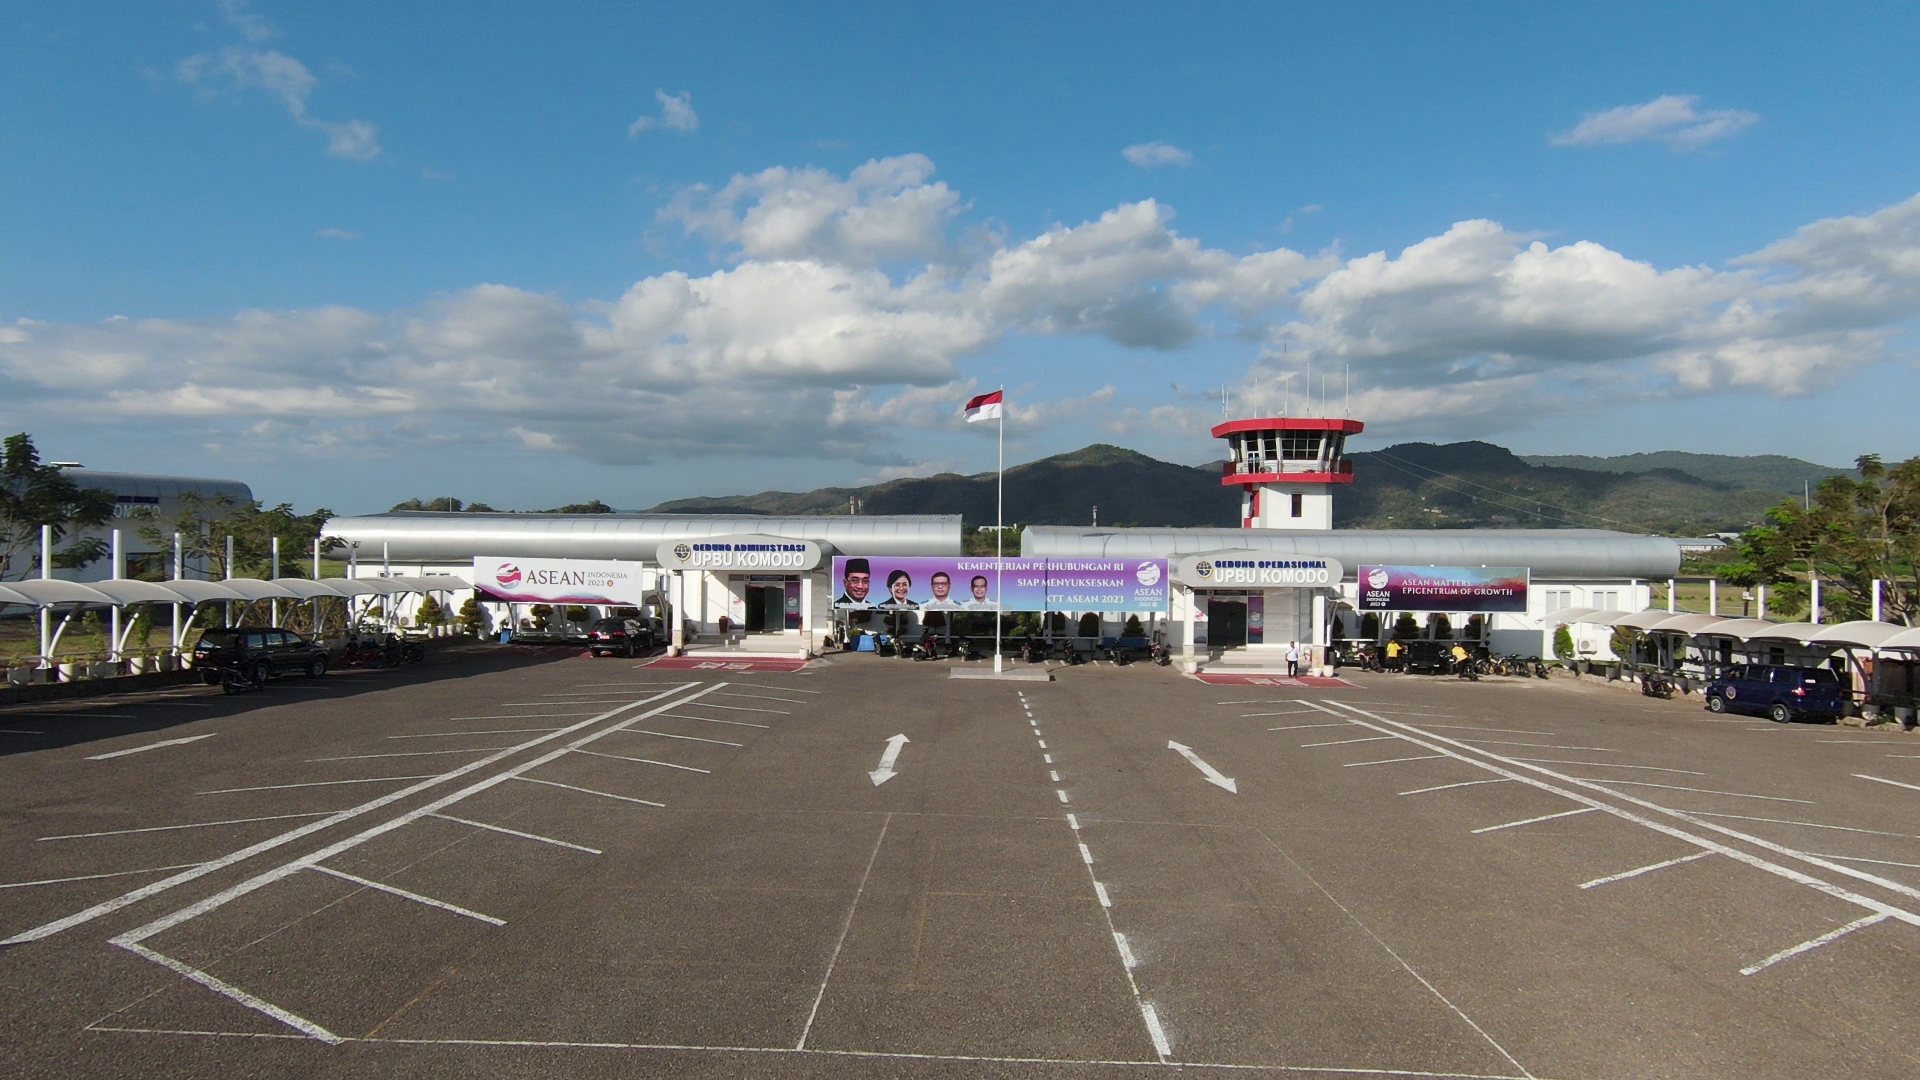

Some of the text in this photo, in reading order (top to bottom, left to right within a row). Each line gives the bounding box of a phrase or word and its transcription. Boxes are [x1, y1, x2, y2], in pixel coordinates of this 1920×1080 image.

[692, 553, 805, 567] UPBU KOMODO
[957, 562, 1124, 571] KEMENTERIAN PERHUBUNGAN RI
[526, 570, 586, 585] ASEAN
[1214, 569, 1329, 584] UPBU KOMODO
[587, 579, 605, 587] 2023
[1017, 578, 1124, 587] SIAP MENYUKSESKAN
[1402, 579, 1430, 587] ASEAN
[1134, 588, 1163, 597] ASEAN
[1402, 587, 1513, 597] EPICENTRUM OF GROWTH
[1066, 594, 1098, 603] ASEAN
[1101, 595, 1124, 604] 2023
